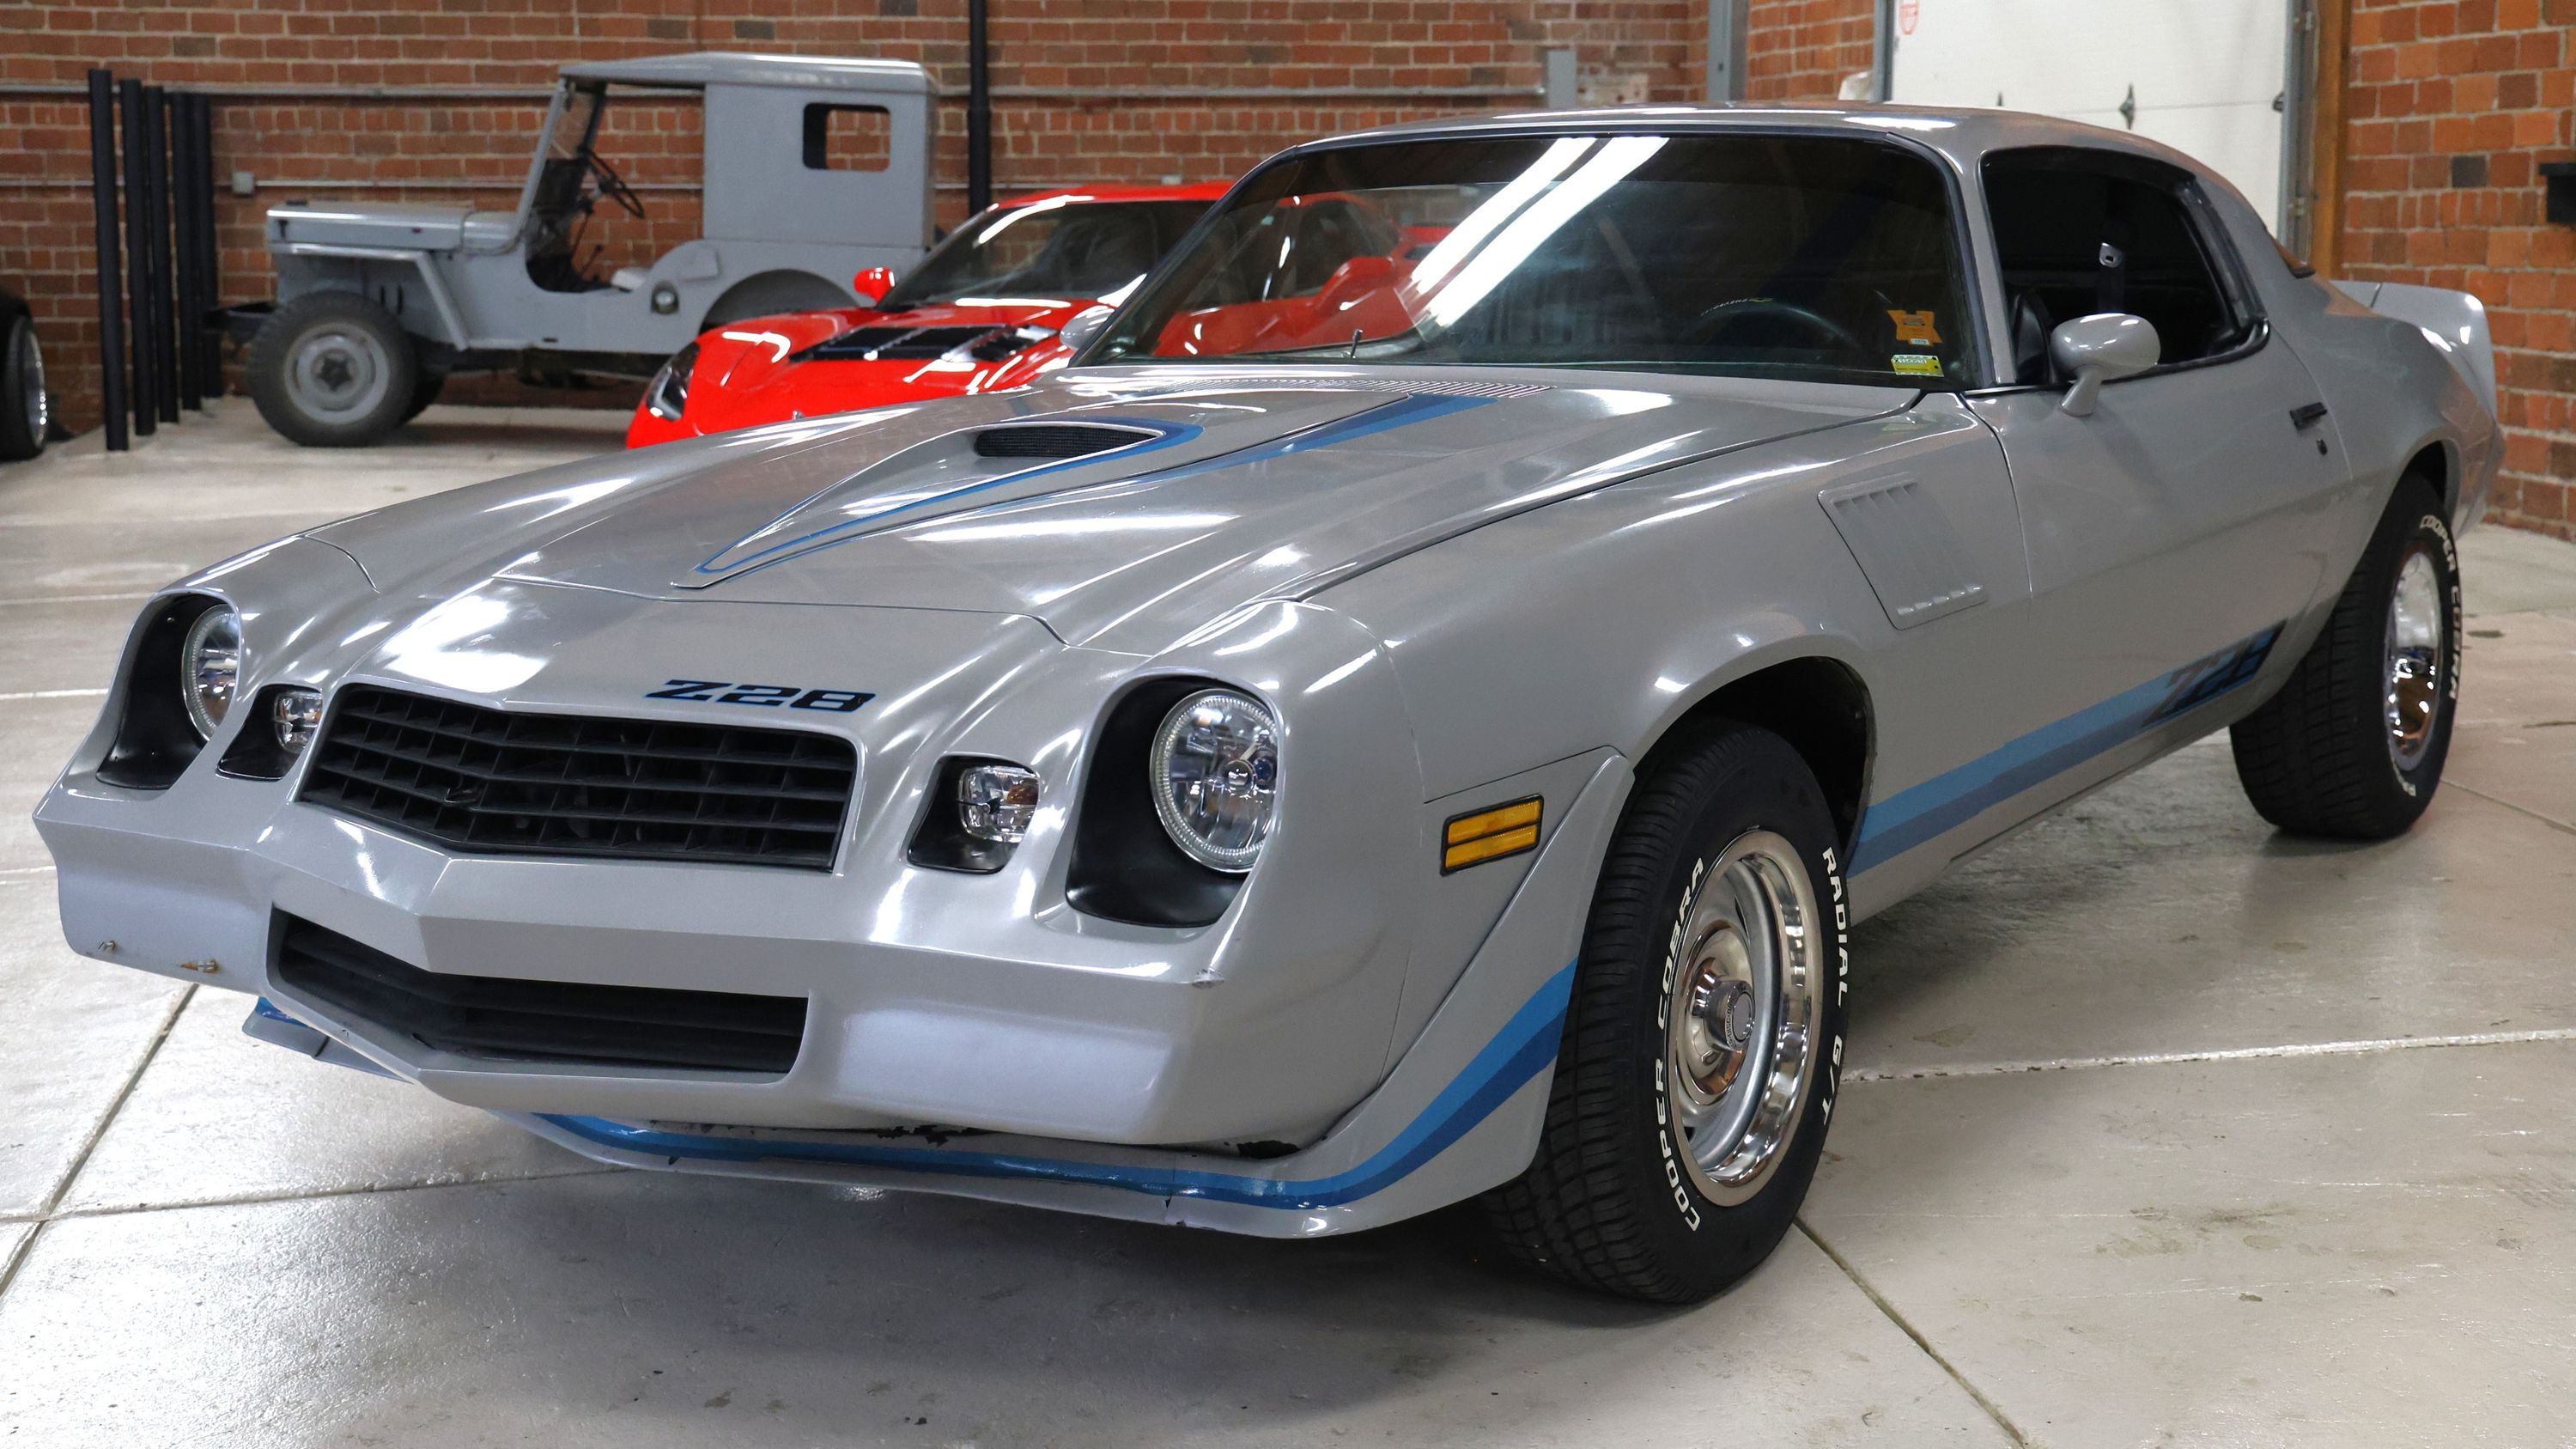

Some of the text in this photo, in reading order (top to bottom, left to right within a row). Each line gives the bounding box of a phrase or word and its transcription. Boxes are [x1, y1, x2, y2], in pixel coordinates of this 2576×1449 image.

[644, 679, 876, 712] Z28
[1655, 857, 1704, 1232] COOPER COBRA
[1820, 846, 1849, 1126] RADIAL G/T
